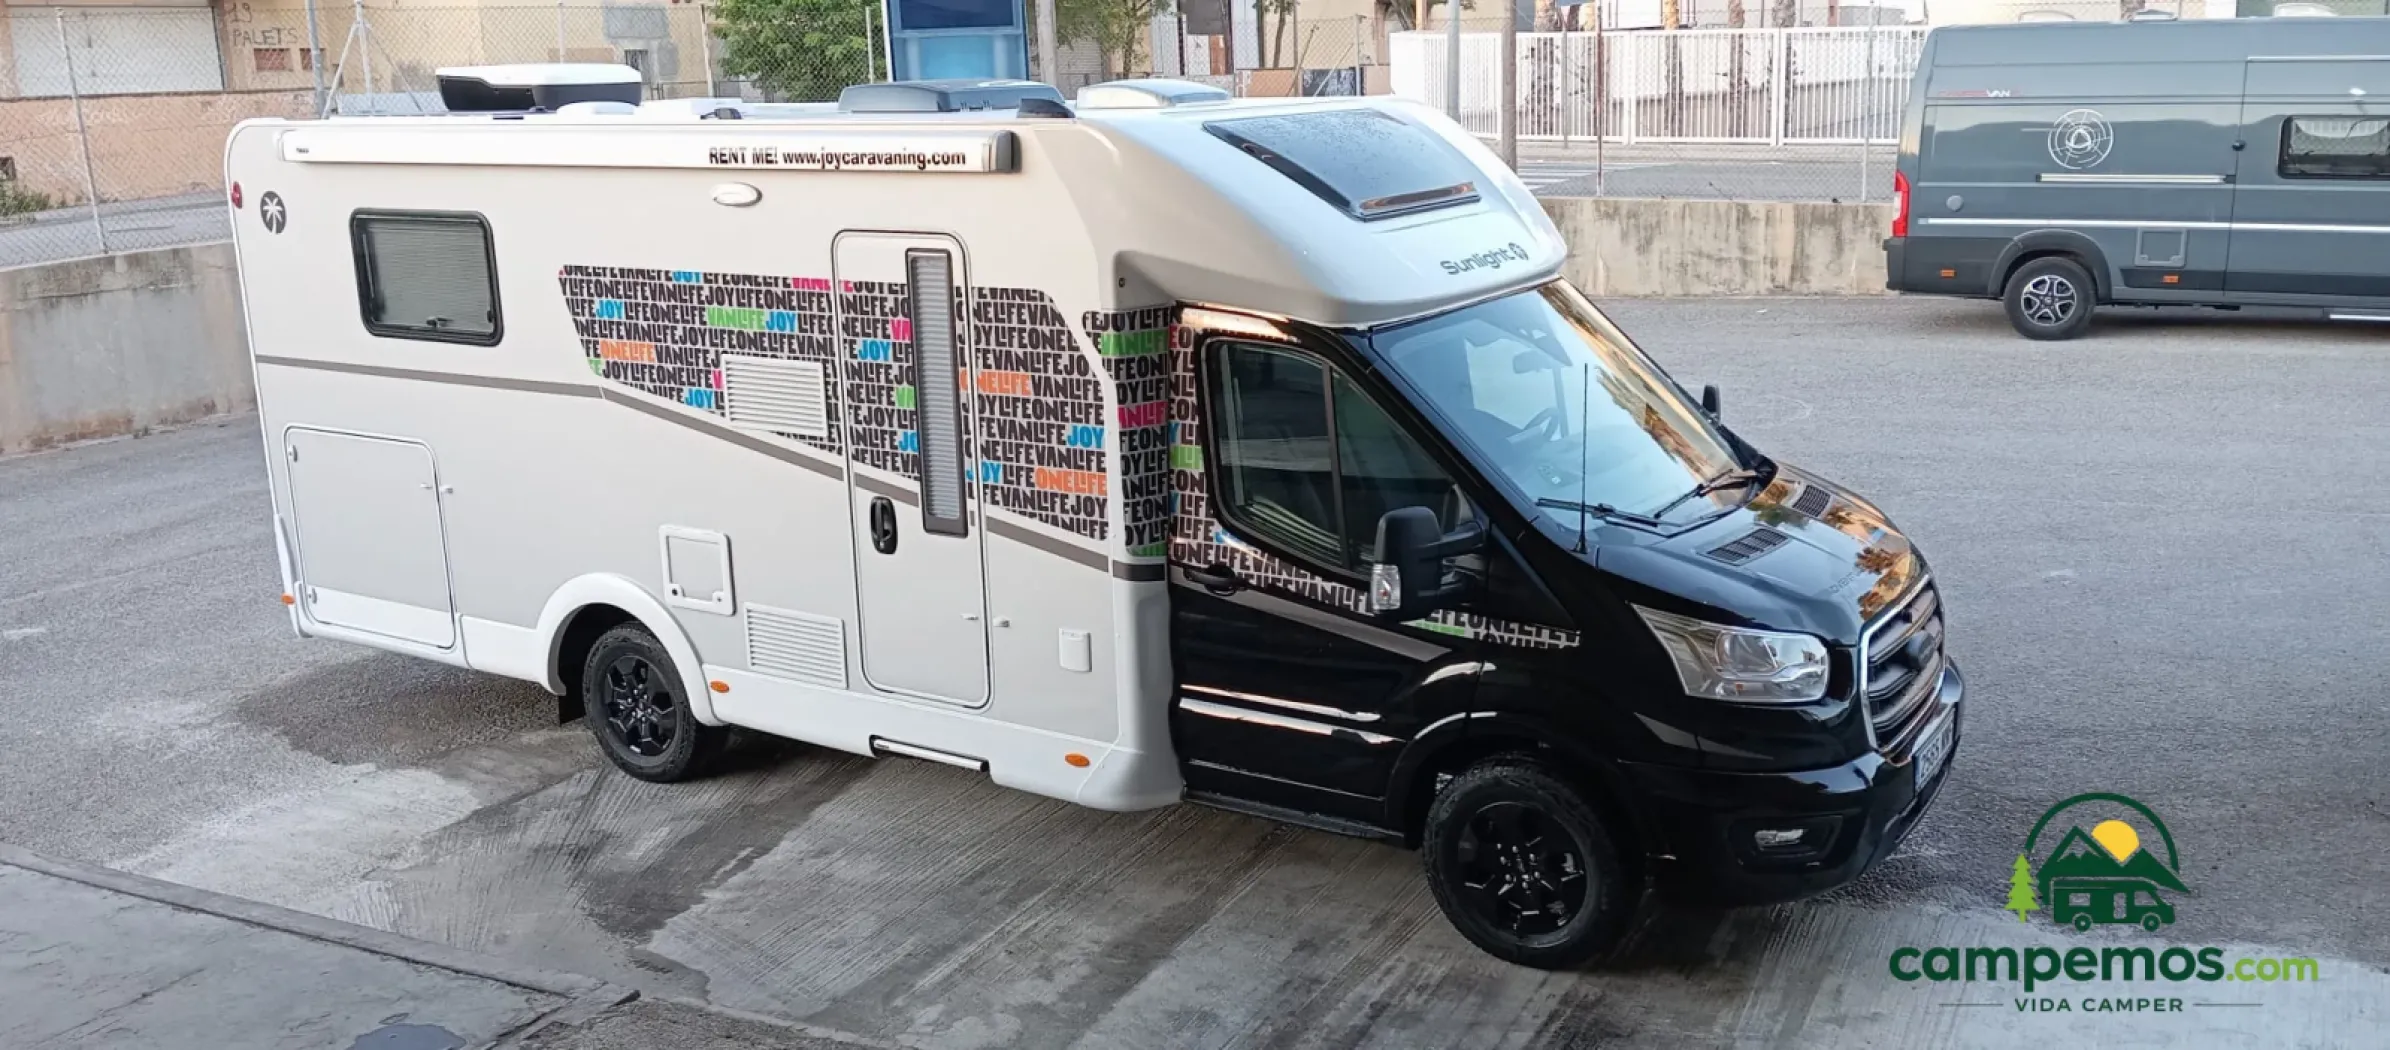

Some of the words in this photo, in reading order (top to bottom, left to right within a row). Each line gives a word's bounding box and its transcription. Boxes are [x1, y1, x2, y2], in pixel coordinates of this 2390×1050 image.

[233, 27, 298, 47] PALETS
[708, 147, 747, 164] RENT
[752, 147, 778, 164] ME!
[783, 146, 967, 170] www.joycaravaning.com
[1440, 247, 1515, 275] Sunlight
[1067, 425, 1105, 449] JOY
